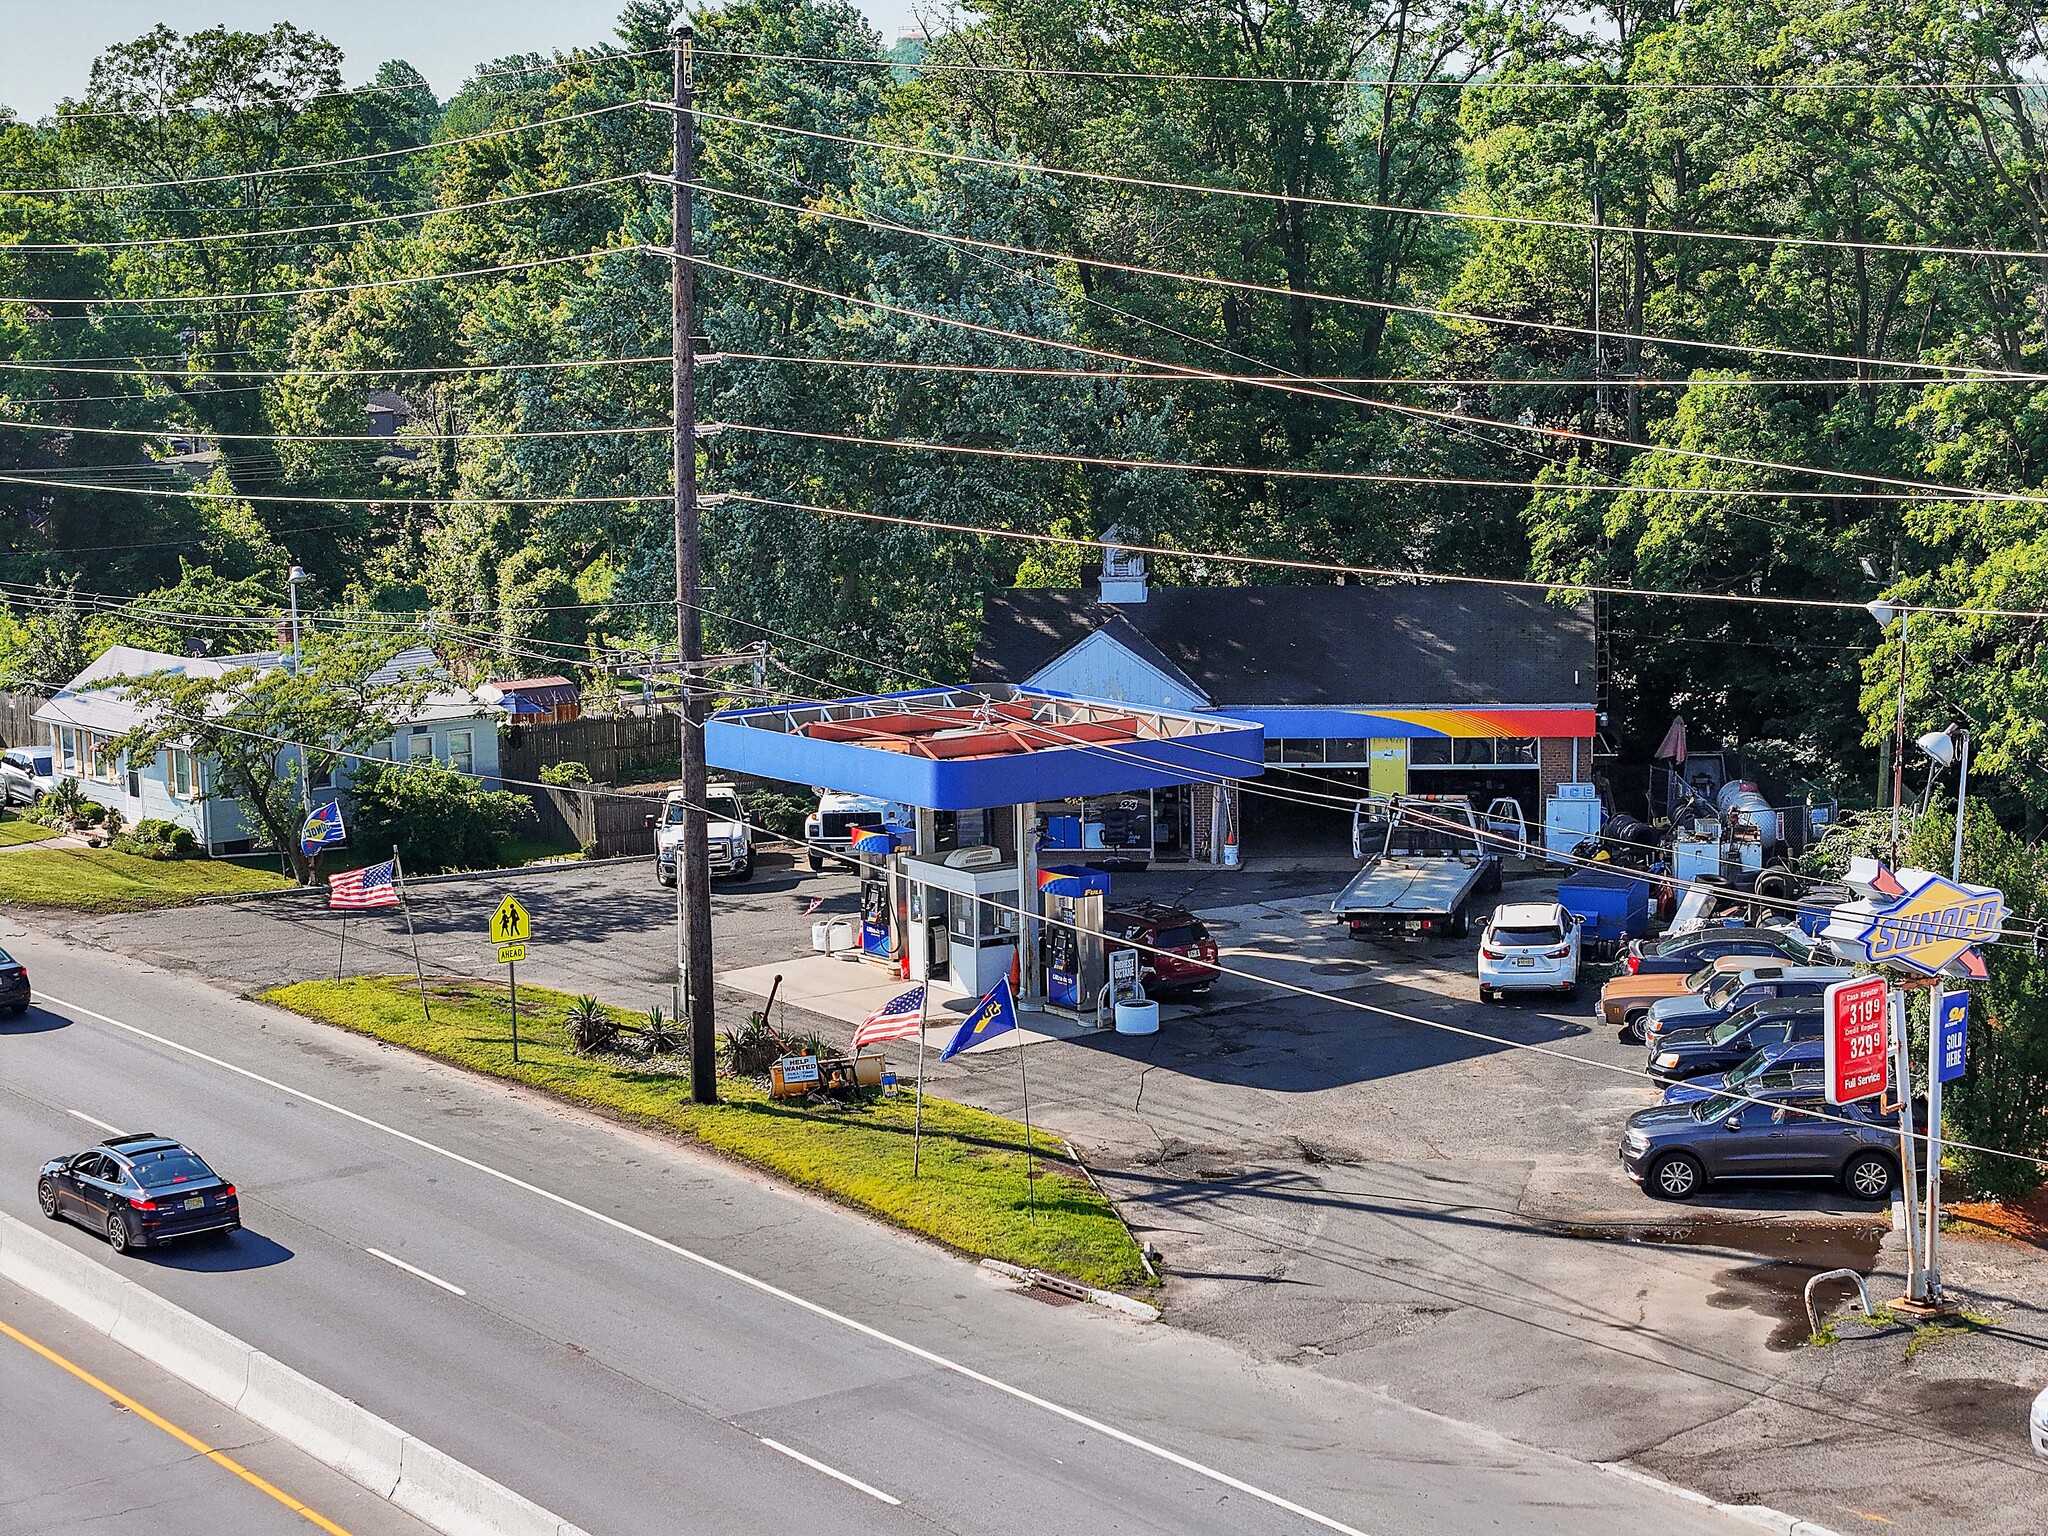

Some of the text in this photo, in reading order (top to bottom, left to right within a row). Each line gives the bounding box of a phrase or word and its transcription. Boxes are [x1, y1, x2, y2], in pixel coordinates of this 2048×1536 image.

[1561, 786, 1593, 798] ICE
[1119, 799, 1138, 811] 94
[1084, 888, 1103, 896] FULL
[1875, 900, 1999, 954] SUNOCO
[501, 948, 523, 959] AHEAD
[1114, 958, 1134, 970] HIGHEST
[1114, 966, 1135, 979] OCTANE
[1846, 988, 1879, 1002] Cash Regular
[1949, 1006, 1966, 1021] 94
[1845, 1022, 1879, 1036] Credit Regular
[1946, 1031, 1962, 1051] SOLD
[790, 1058, 809, 1066] HELP
[1946, 1049, 1962, 1069] HERE
[784, 1063, 817, 1073] WANTED
[1844, 1072, 1881, 1090] Full Service
